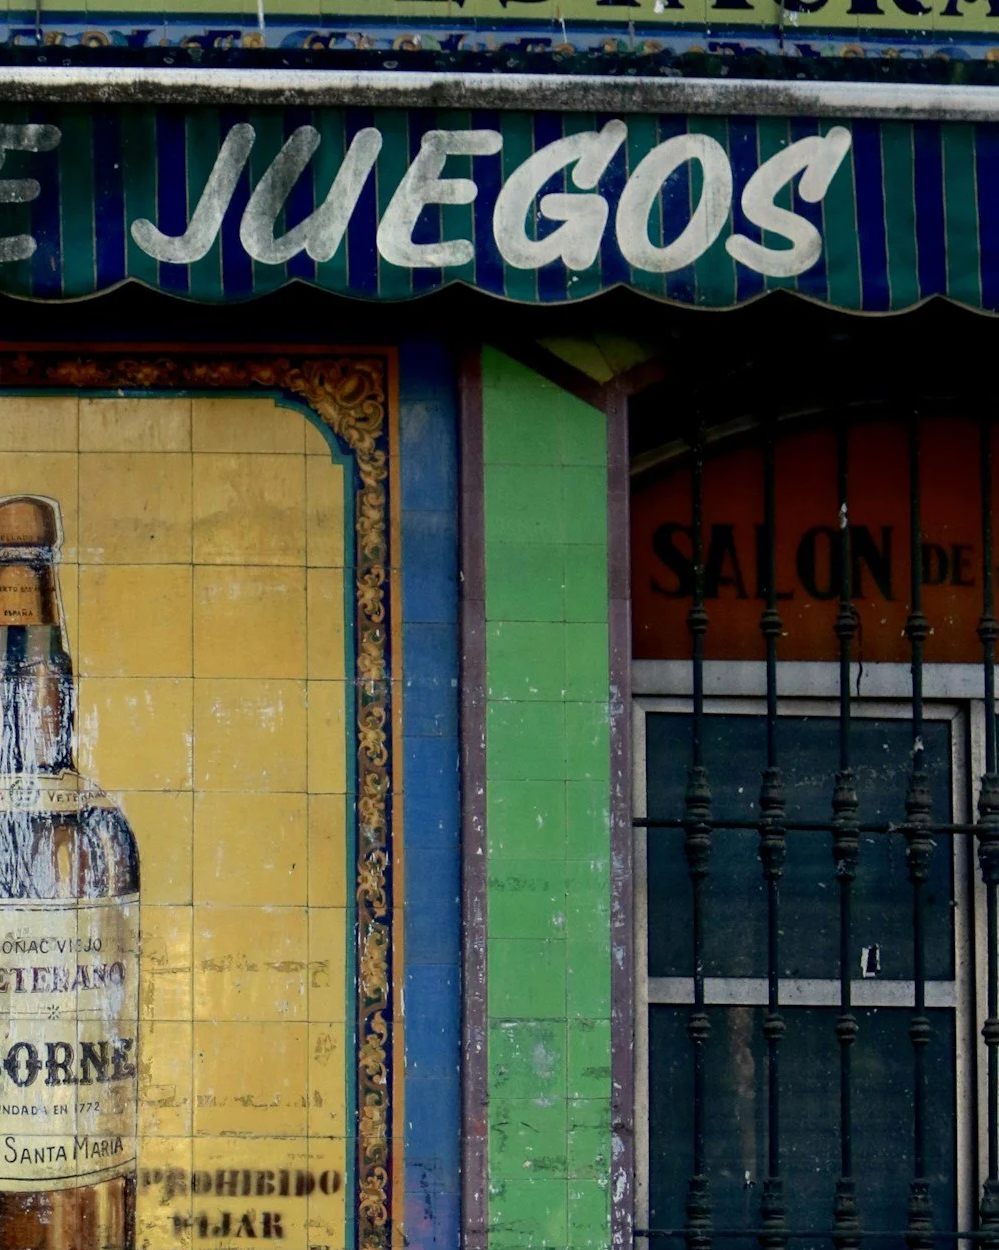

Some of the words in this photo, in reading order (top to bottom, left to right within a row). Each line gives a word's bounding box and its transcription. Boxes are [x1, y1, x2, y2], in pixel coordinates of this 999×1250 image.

[130, 119, 852, 278] JUEGOS
[651, 522, 895, 602] SALON
[921, 543, 975, 587] DE
[57, 938, 103, 953] VIEJO
[54, 1104, 68, 1115] EN
[137, 1167, 342, 1197] PROHIBIDO
